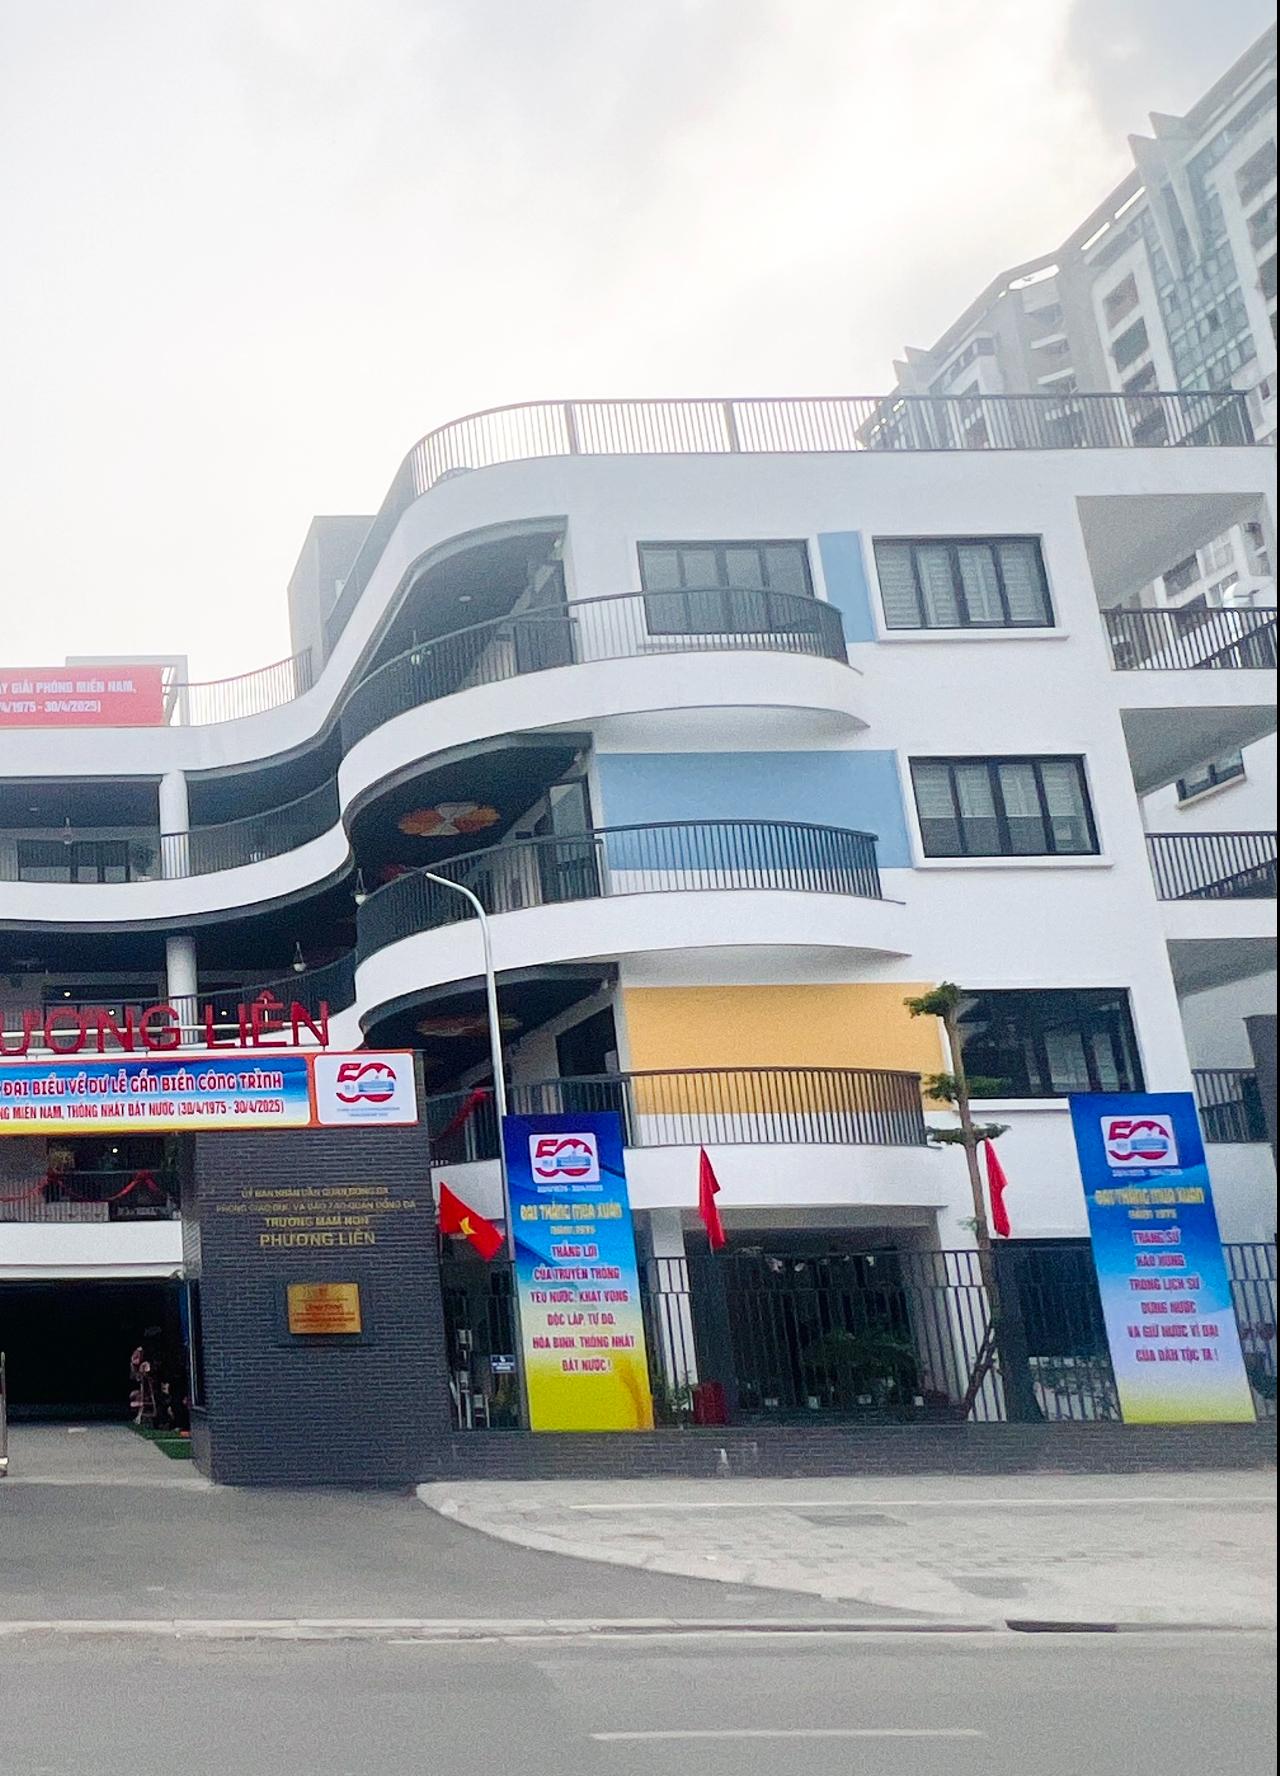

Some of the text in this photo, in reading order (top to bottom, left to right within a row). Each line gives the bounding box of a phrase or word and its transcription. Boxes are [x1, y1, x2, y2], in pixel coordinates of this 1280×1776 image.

[206, 990, 329, 1049] LIÊN
[4, 1081, 29, 1101] ĐẠI
[32, 1073, 64, 1096] BIỂU
[69, 1072, 86, 1095] VỀ
[89, 1074, 110, 1097] DỰ
[111, 1069, 127, 1093] LỄ
[130, 1069, 157, 1093] GẮN
[161, 1068, 194, 1091] BIỂN
[198, 1070, 236, 1090] CÔNG
[239, 1068, 283, 1089] TRÌNH
[335, 1062, 397, 1103] 50
[12, 1102, 36, 1119] MIỀN
[40, 1105, 65, 1120] NAM,
[67, 1102, 98, 1119] THỐNG
[101, 1099, 125, 1117] NHẤT
[128, 1100, 145, 1117] ĐẤT
[149, 1100, 174, 1116] NƯỚC
[178, 1101, 226, 1116] (30/4/1975
[234, 1099, 284, 1114] 30/4/2025)
[1108, 1120, 1169, 1161] 50
[534, 1138, 593, 1177] 50
[344, 1216, 369, 1226] NON
[259, 1228, 376, 1248] PHƯƠNG LIÊN
[534, 1263, 619, 1281] CỦA TRUYỀN THỐNG
[580, 1332, 609, 1348] THỐNG
[611, 1332, 635, 1348] NHẤT
[562, 1356, 580, 1372] ĐẤT
